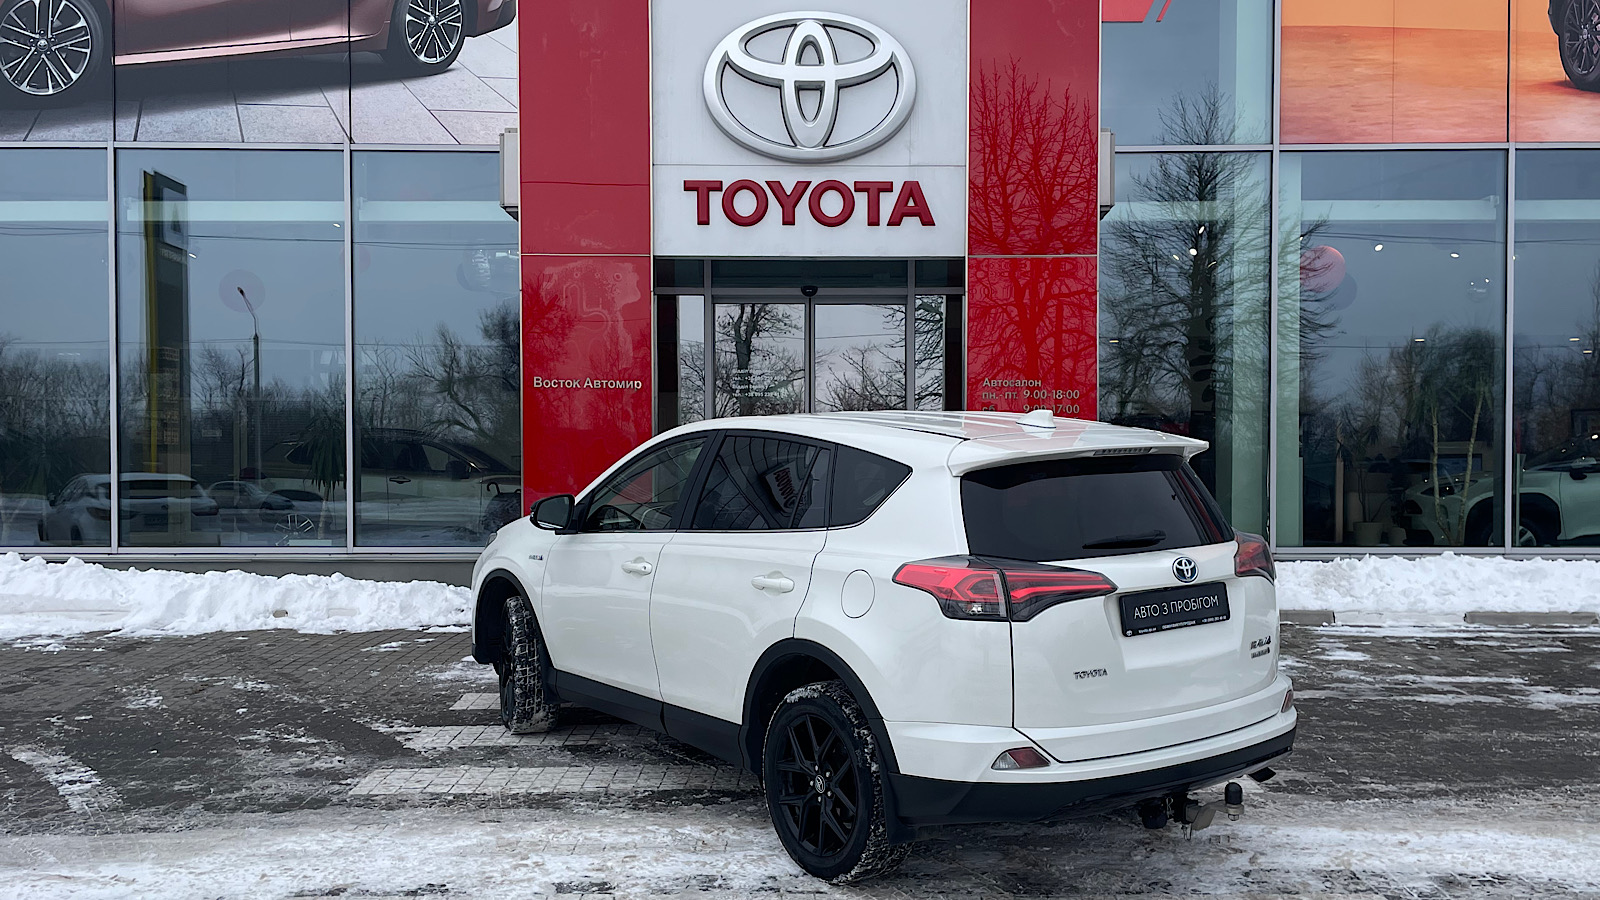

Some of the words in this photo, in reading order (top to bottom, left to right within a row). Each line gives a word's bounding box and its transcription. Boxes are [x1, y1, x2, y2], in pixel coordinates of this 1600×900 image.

[683, 179, 936, 227] TOYOTA
[533, 376, 581, 388] Восток
[583, 377, 642, 391] Автомир
[982, 378, 1042, 387] Автосалон
[1134, 604, 1160, 620] АВТО
[1170, 595, 1219, 613] ПРОБІГОМ
[1073, 668, 1108, 680] TOYOTA
